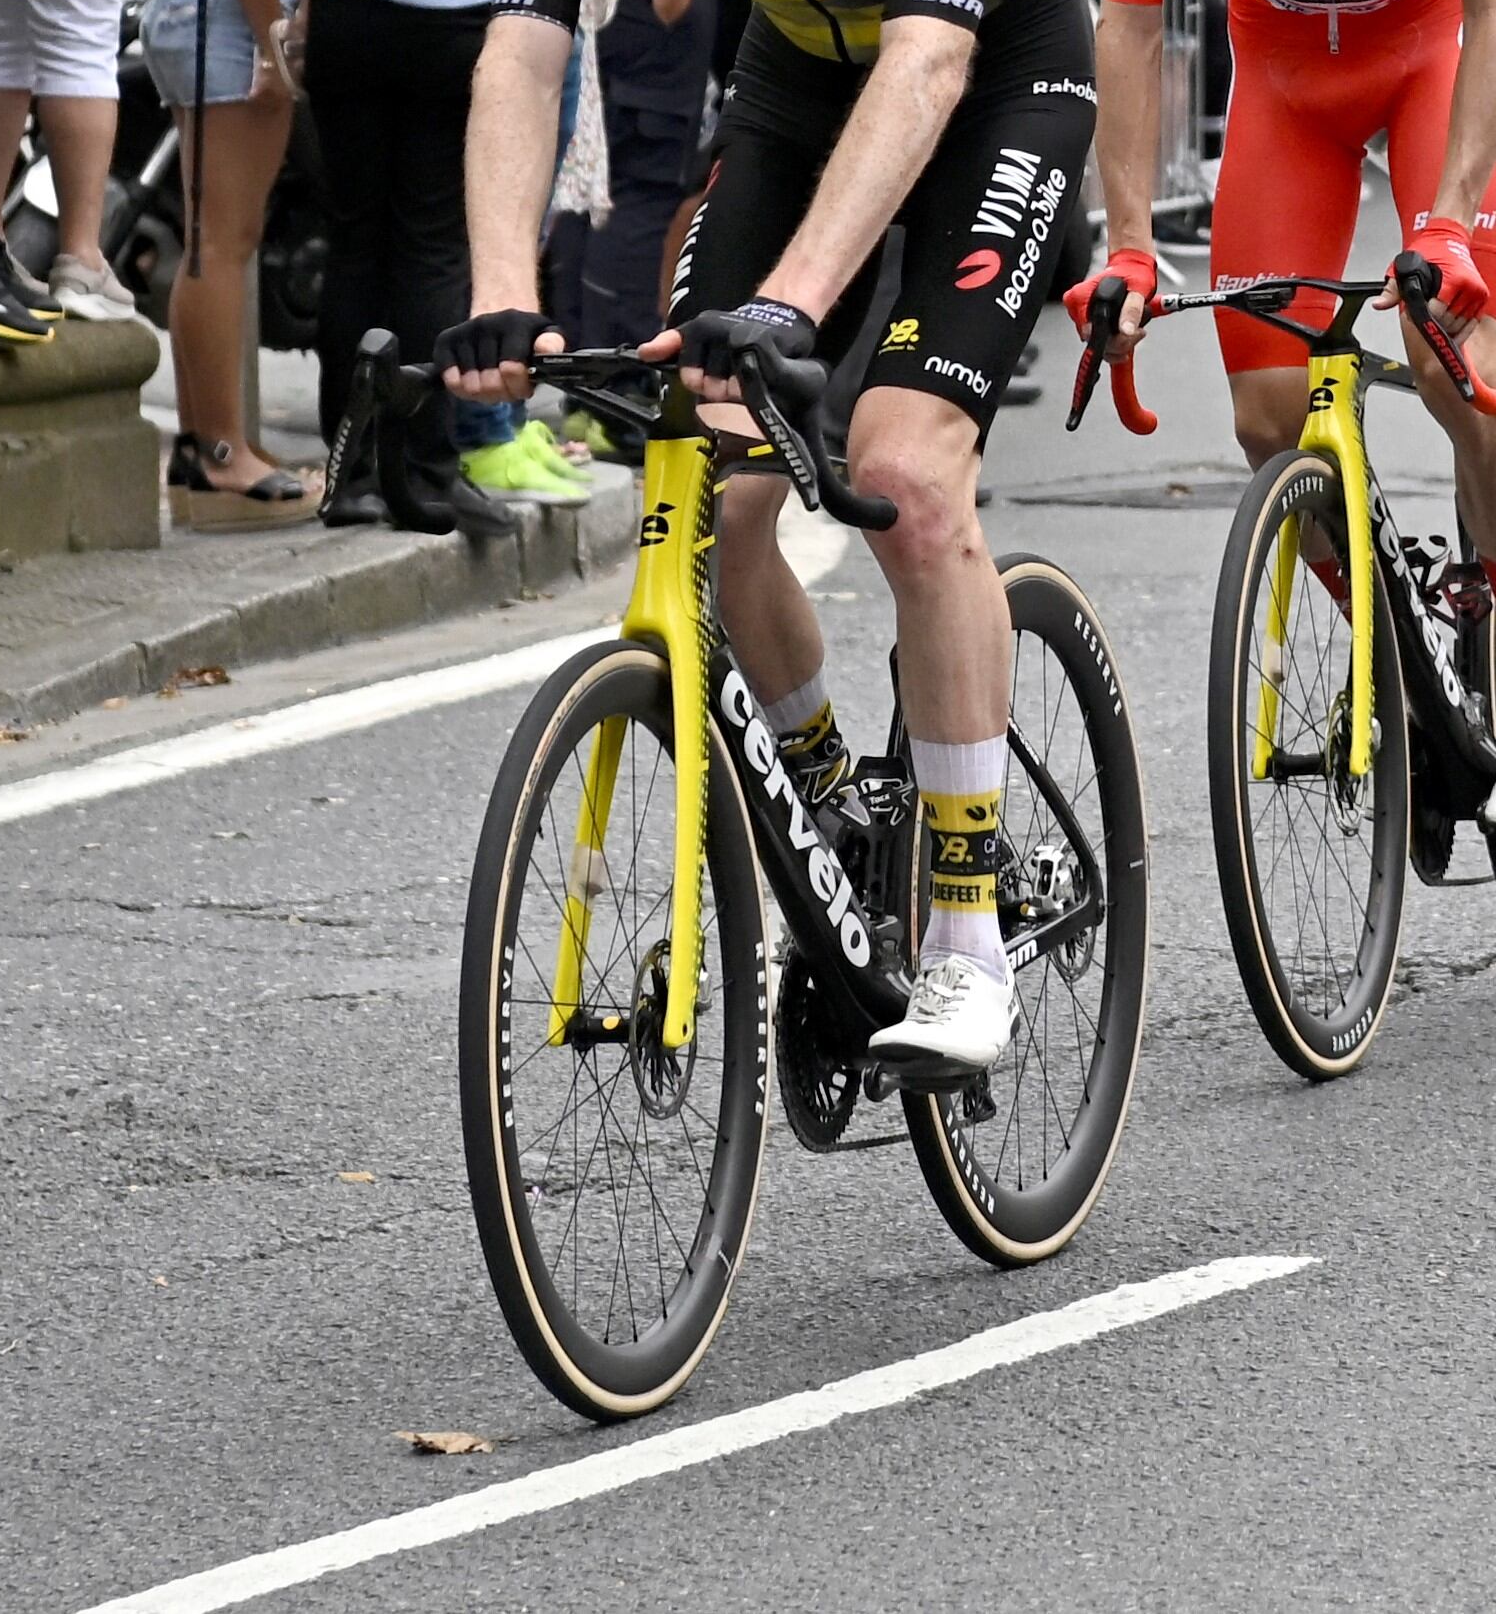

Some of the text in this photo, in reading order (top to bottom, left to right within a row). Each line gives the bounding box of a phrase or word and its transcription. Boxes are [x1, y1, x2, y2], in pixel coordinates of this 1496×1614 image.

[970, 147, 1042, 240] VISMA
[924, 354, 992, 399] nimbl
[1424, 320, 1467, 380] SRAM
[758, 406, 813, 485] SRAM
[1281, 475, 1325, 513] RESERVE
[1073, 610, 1123, 717] RESERVE
[720, 669, 871, 969] cervélo
[934, 882, 981, 904] DEFEET
[754, 941, 767, 1117] RESERVE
